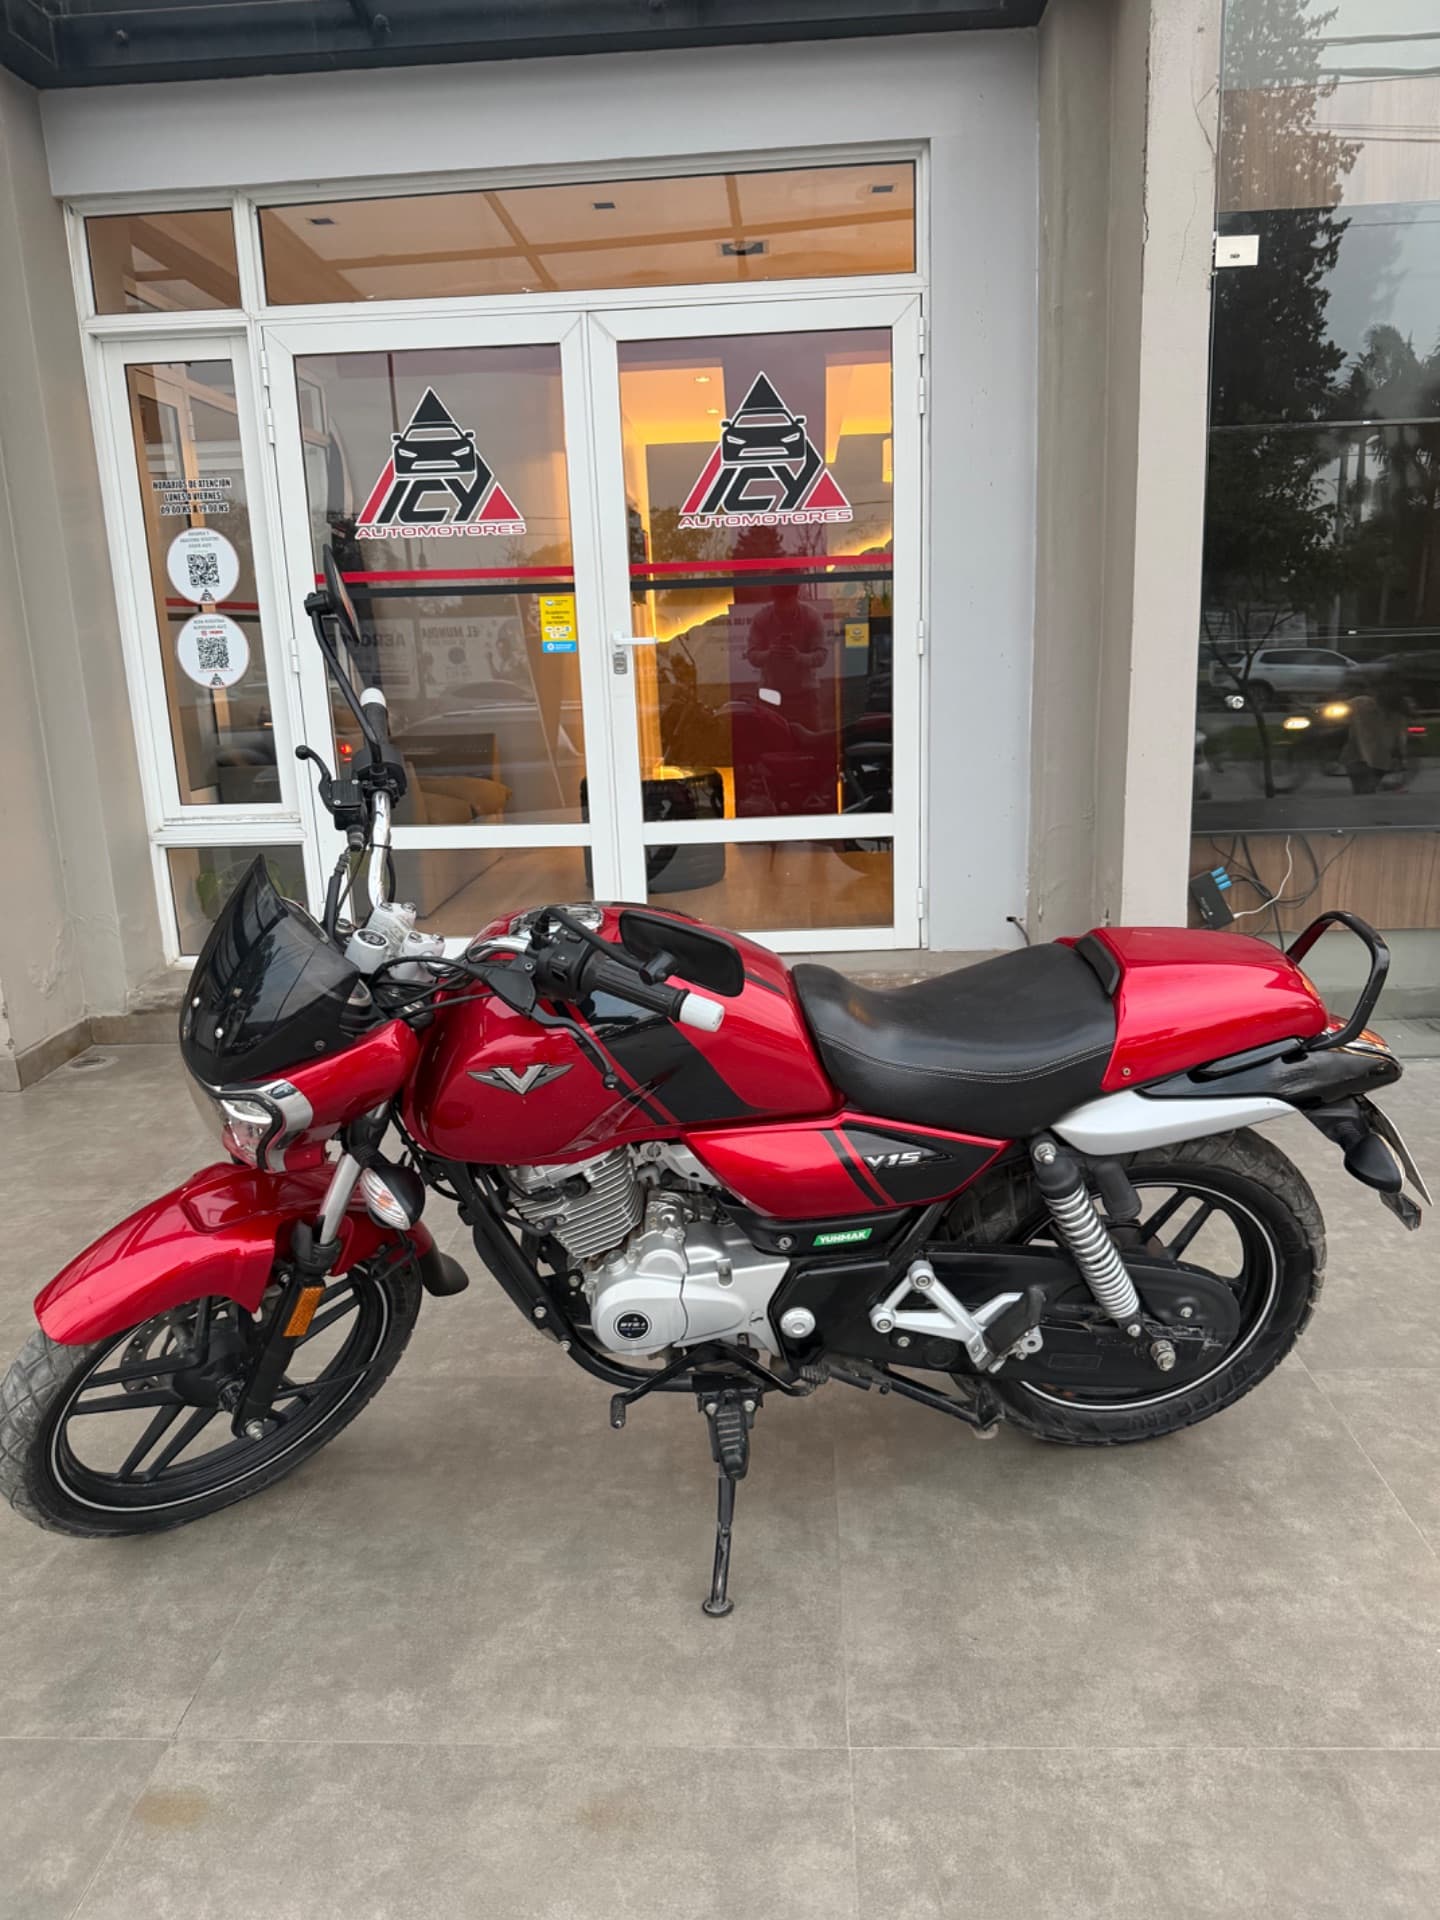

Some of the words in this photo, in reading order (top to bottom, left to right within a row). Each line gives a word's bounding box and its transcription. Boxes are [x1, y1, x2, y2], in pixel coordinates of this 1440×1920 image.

[165, 492, 185, 501] LUNES
[193, 491, 221, 500] VIERNES
[679, 510, 852, 529] AUTOMOTORES
[355, 523, 526, 539] AUTOMOTORES
[865, 1151, 922, 1169] V15
